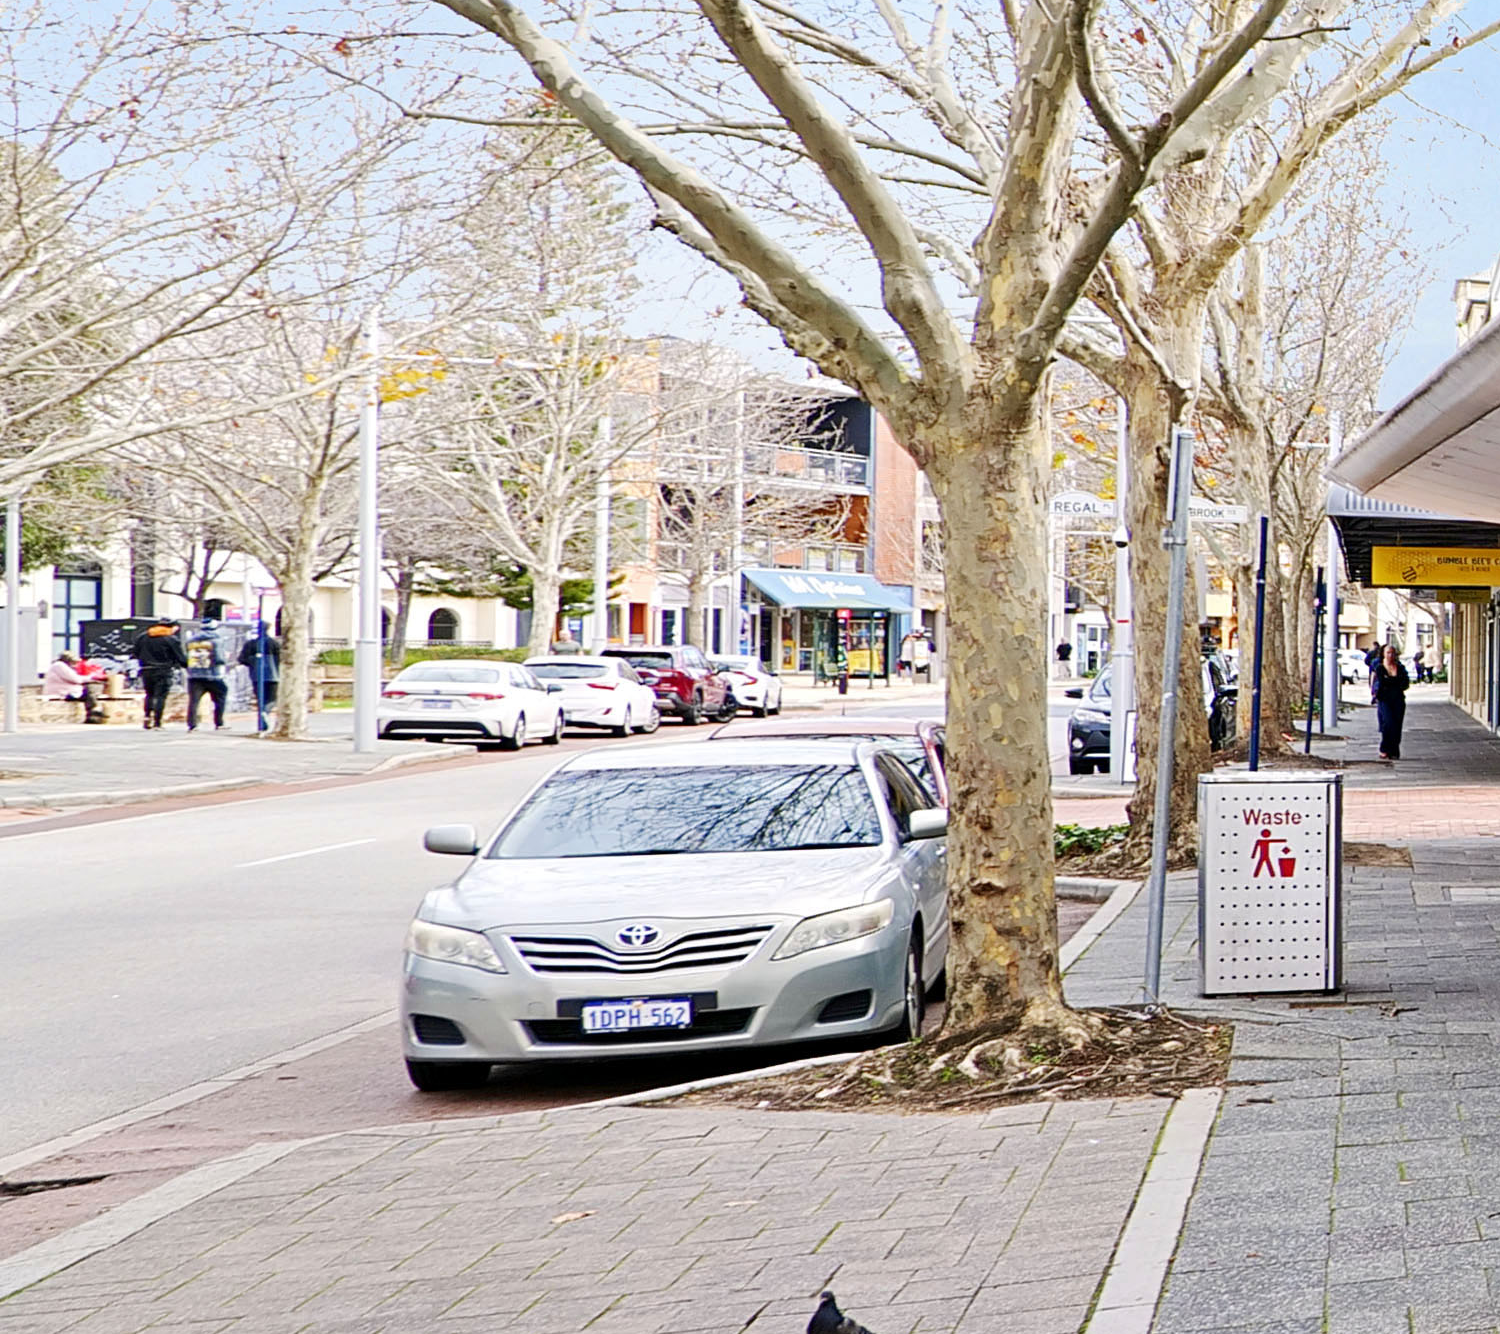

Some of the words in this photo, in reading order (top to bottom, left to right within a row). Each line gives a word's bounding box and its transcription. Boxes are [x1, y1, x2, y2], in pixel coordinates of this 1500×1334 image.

[1054, 501, 1099, 513] REGAL
[1437, 557, 1468, 565] BUMBLE
[1242, 809, 1302, 825] Waste
